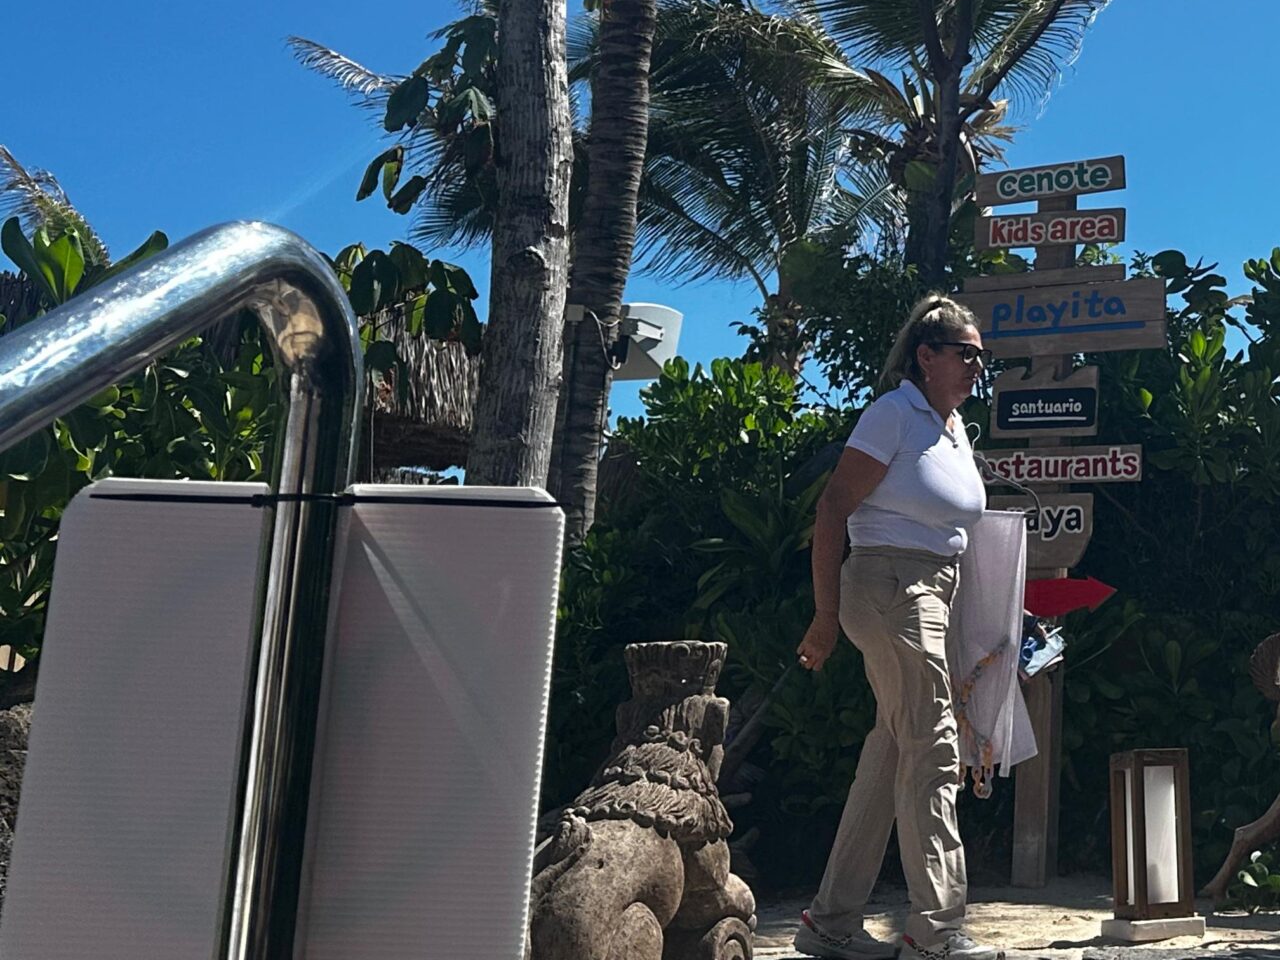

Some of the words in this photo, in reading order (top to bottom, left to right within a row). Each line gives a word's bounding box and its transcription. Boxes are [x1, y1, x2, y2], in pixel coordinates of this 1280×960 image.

[998, 161, 1112, 198] cenote
[1049, 215, 1116, 241] area
[991, 290, 1127, 338] playita
[1011, 397, 1083, 417] santuario
[977, 448, 1139, 480] estaurants
[1008, 505, 1084, 539] aya
